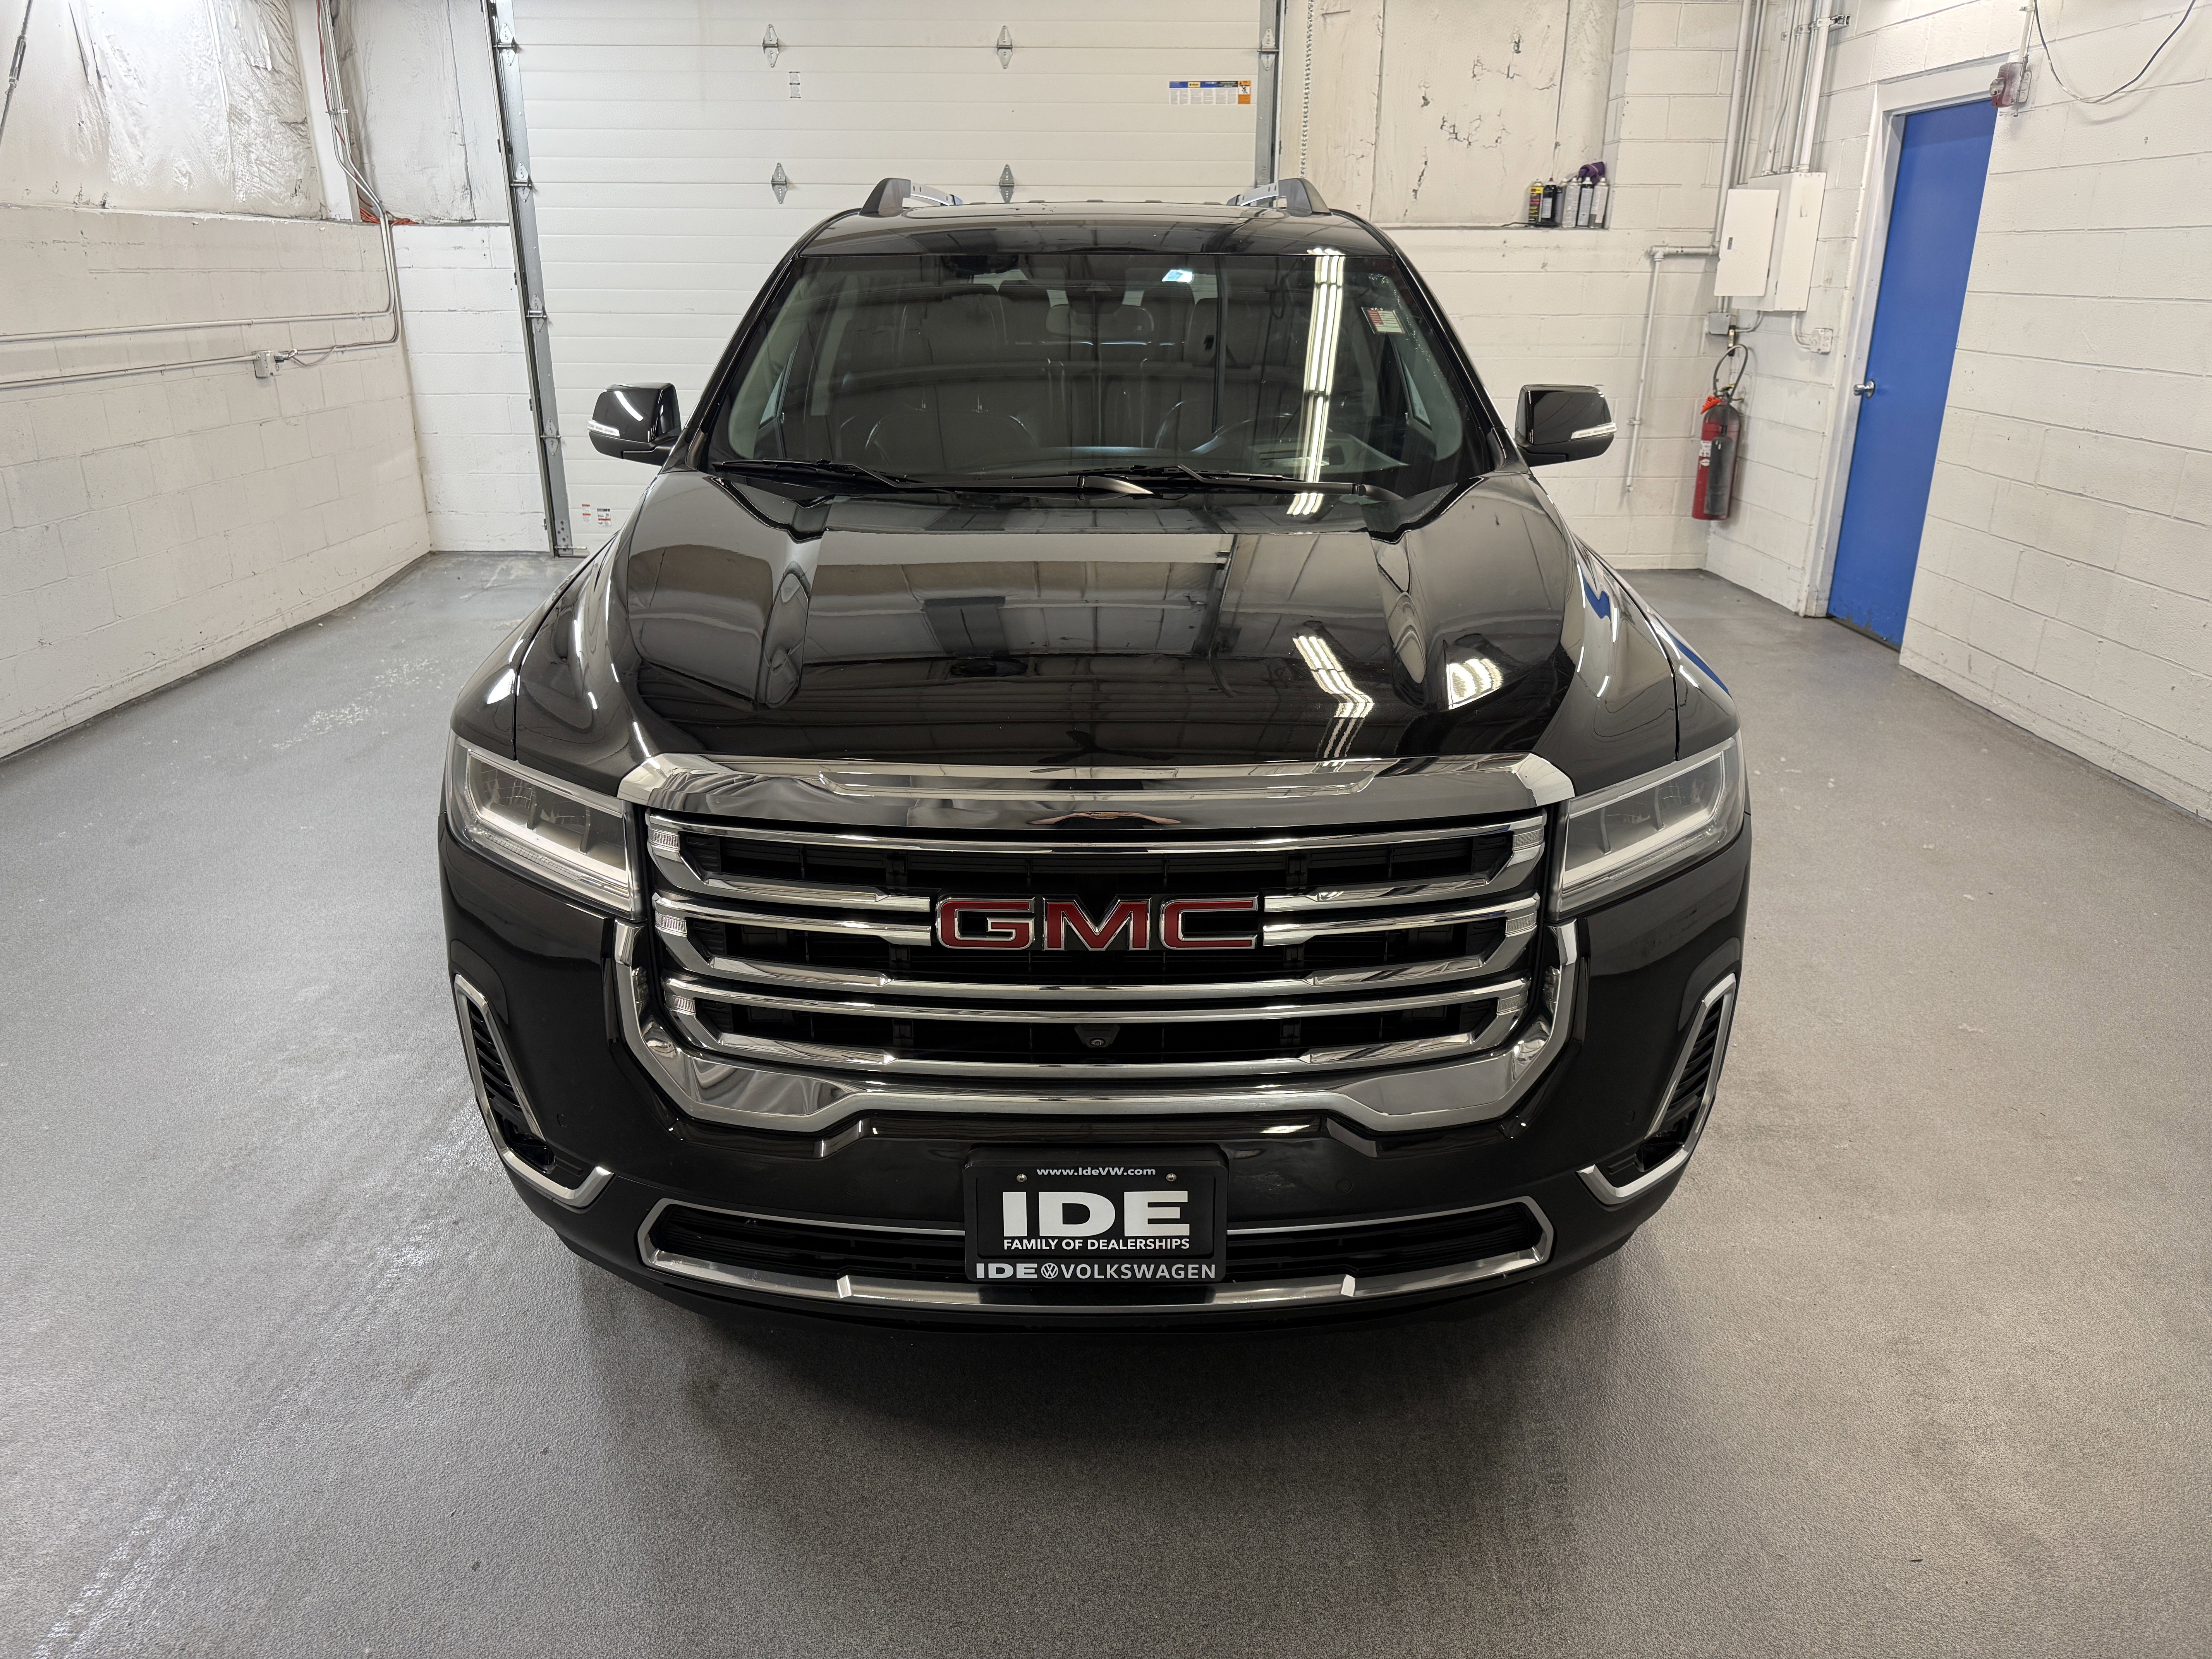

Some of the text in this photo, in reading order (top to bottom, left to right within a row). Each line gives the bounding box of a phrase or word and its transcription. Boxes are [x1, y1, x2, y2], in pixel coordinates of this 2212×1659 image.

[935, 894, 1259, 951] GMC
[1036, 1167, 1156, 1176] www.IdeVW.com
[1003, 1190, 1190, 1237] IDE
[1004, 1238, 1190, 1250] FAMILY OF DEALERSHIPS
[976, 1263, 1038, 1279] IDE
[1060, 1264, 1215, 1279] VOLKSWAGEN
